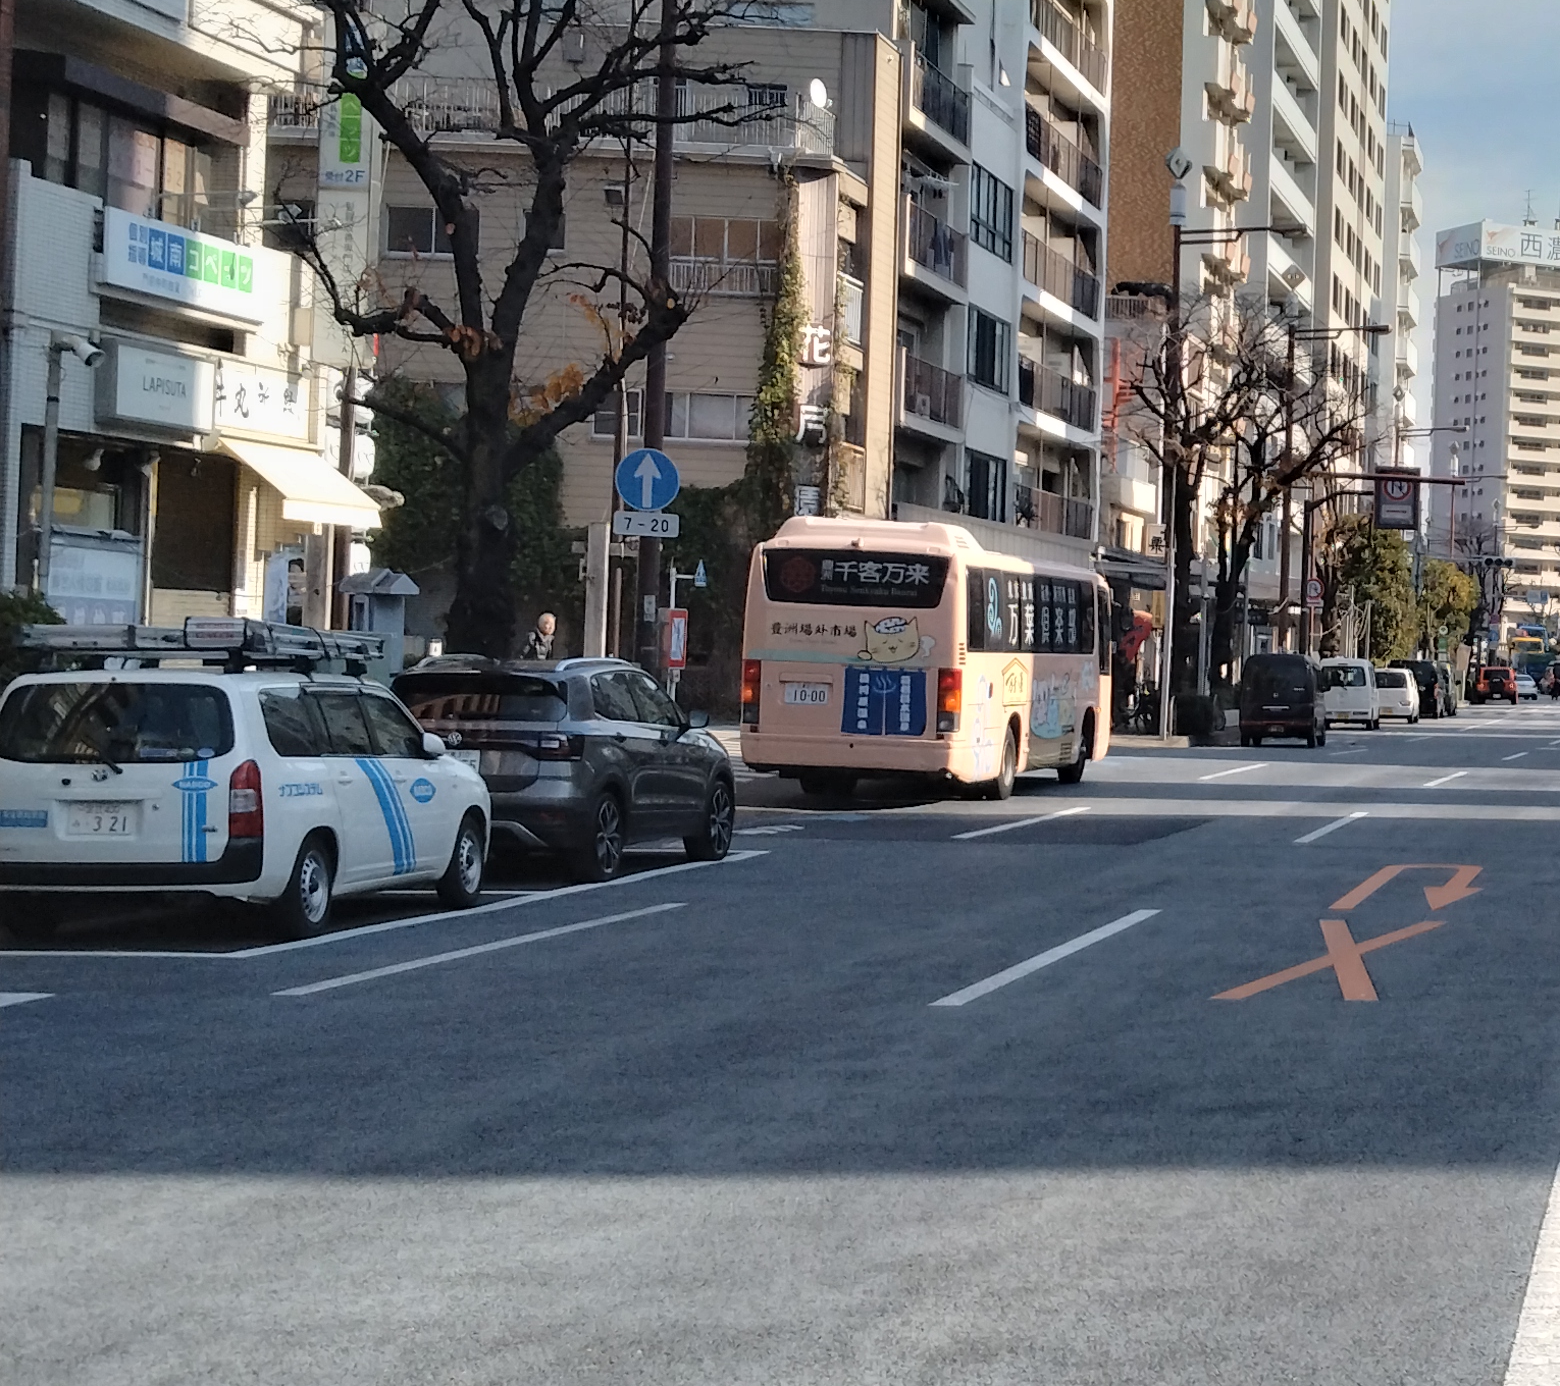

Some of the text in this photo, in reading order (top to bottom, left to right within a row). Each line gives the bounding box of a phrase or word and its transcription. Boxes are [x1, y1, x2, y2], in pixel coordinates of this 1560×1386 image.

[1454, 238, 1480, 259] SEINO
[1486, 245, 1516, 258] SEINO
[142, 375, 188, 398] LAPISUTA
[623, 516, 670, 533] 7-20
[834, 560, 930, 586] 千客万来
[792, 689, 827, 703] 10-00
